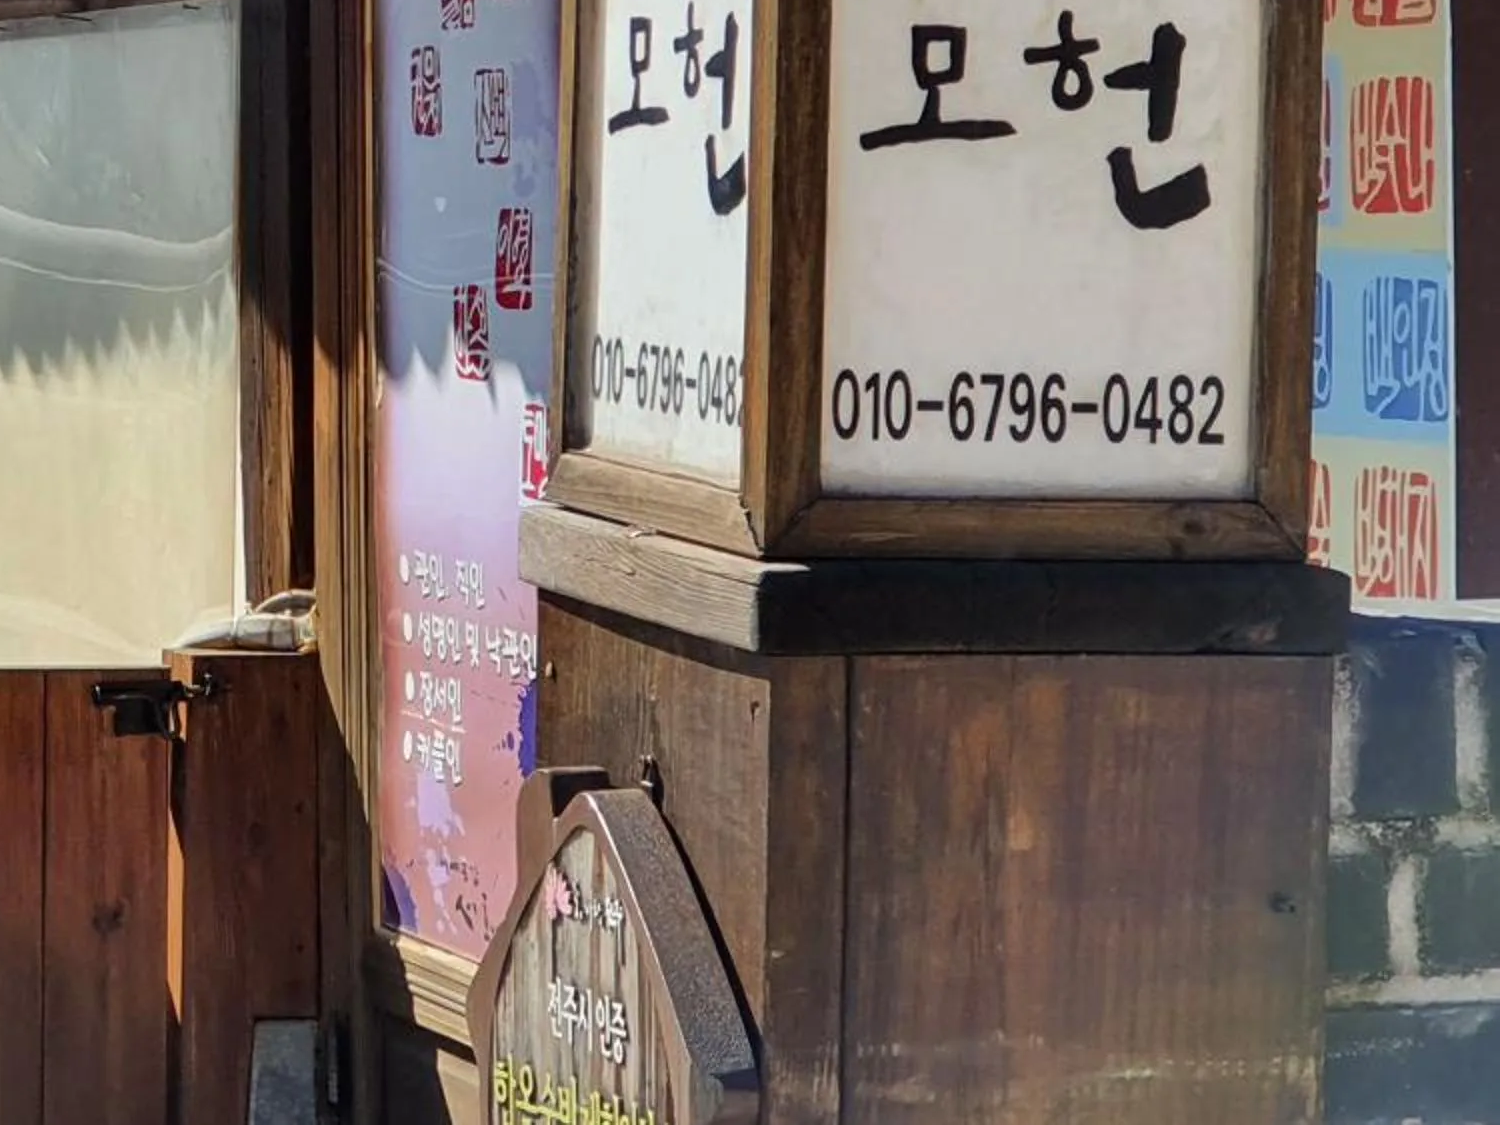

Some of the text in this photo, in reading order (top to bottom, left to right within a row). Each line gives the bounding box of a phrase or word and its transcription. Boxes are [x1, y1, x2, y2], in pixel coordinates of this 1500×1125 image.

[607, 0, 746, 216] 모헌
[859, 9, 1211, 230] 모헌
[830, 368, 1226, 445] 010-6796-0482
[418, 611, 463, 664] 성명인
[484, 625, 538, 679] 낙관인
[419, 671, 463, 724] 장서인
[548, 976, 629, 1064] 전주시 인증
